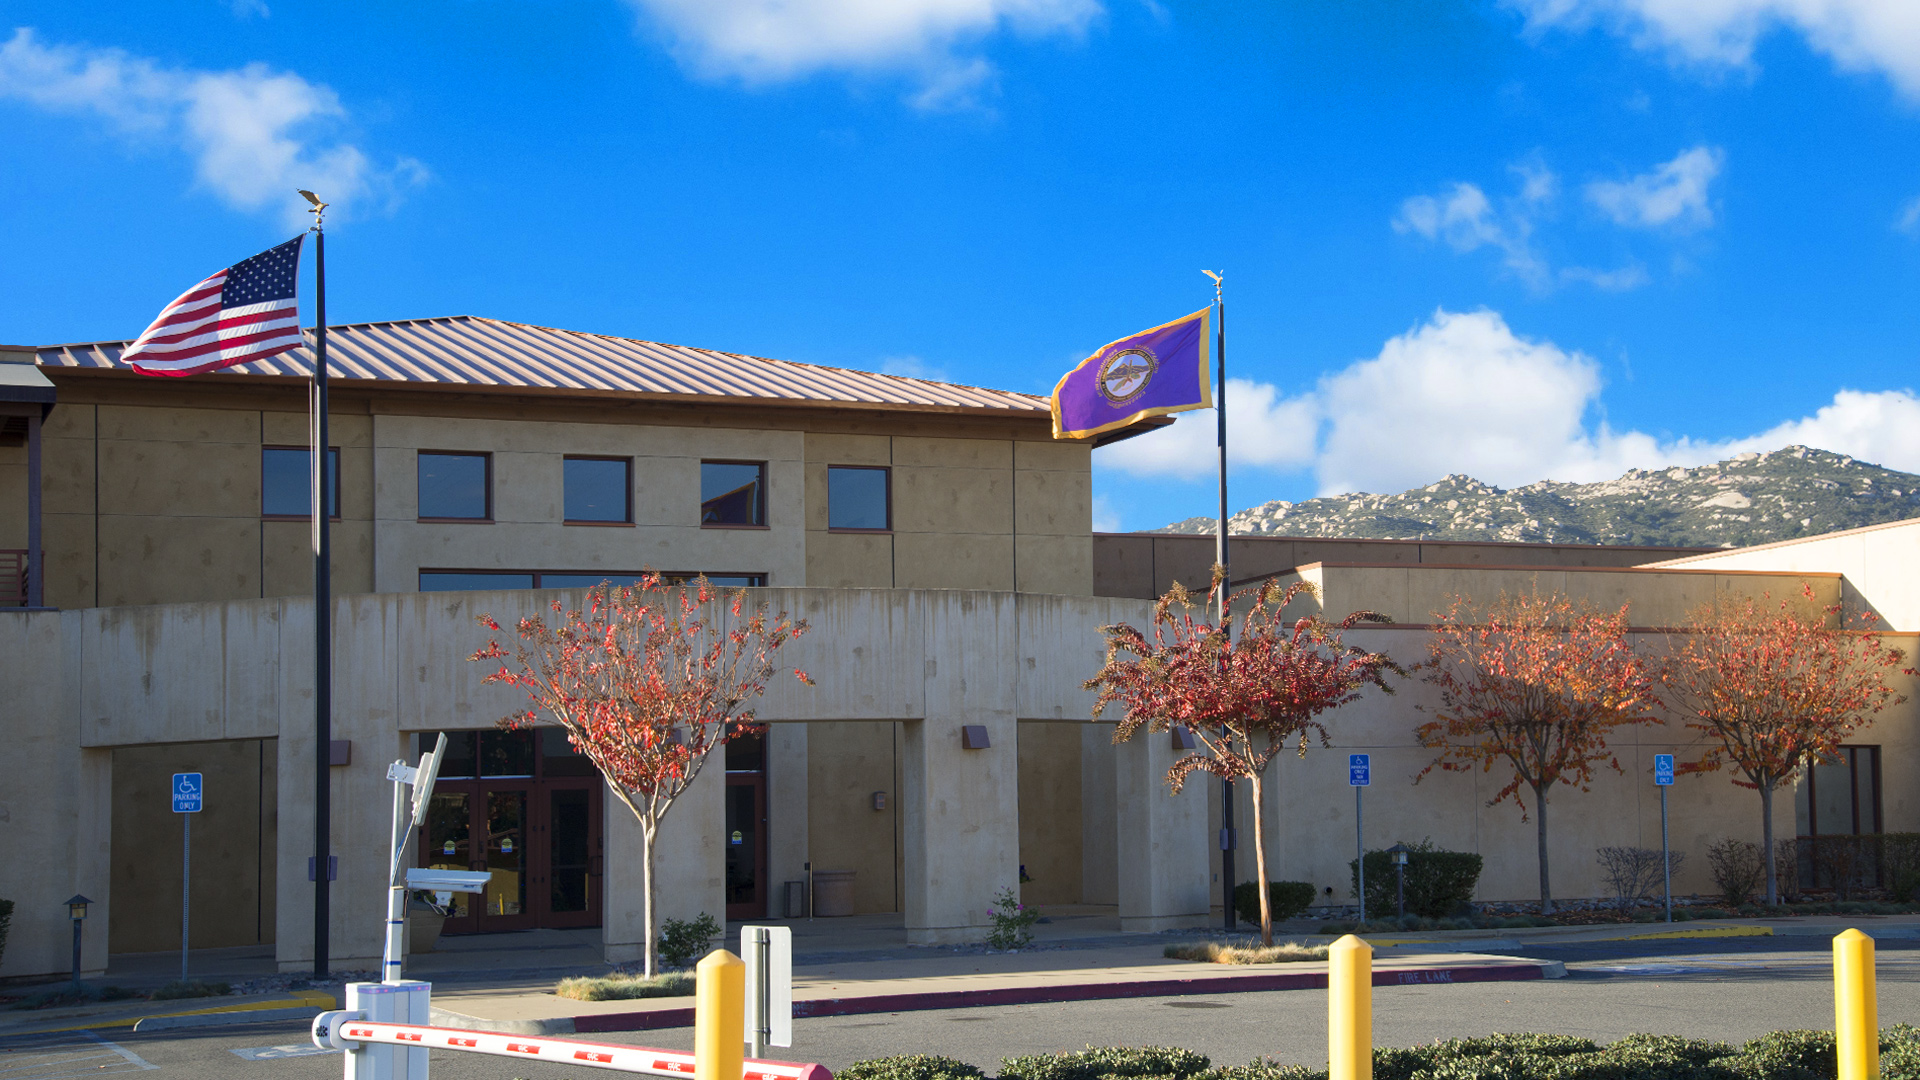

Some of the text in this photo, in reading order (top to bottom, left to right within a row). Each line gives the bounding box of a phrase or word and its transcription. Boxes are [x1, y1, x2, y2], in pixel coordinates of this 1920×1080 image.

[174, 793, 201, 802] PARKING
[179, 801, 196, 810] ONLY
[1398, 970, 1453, 984] FIRE LANE
